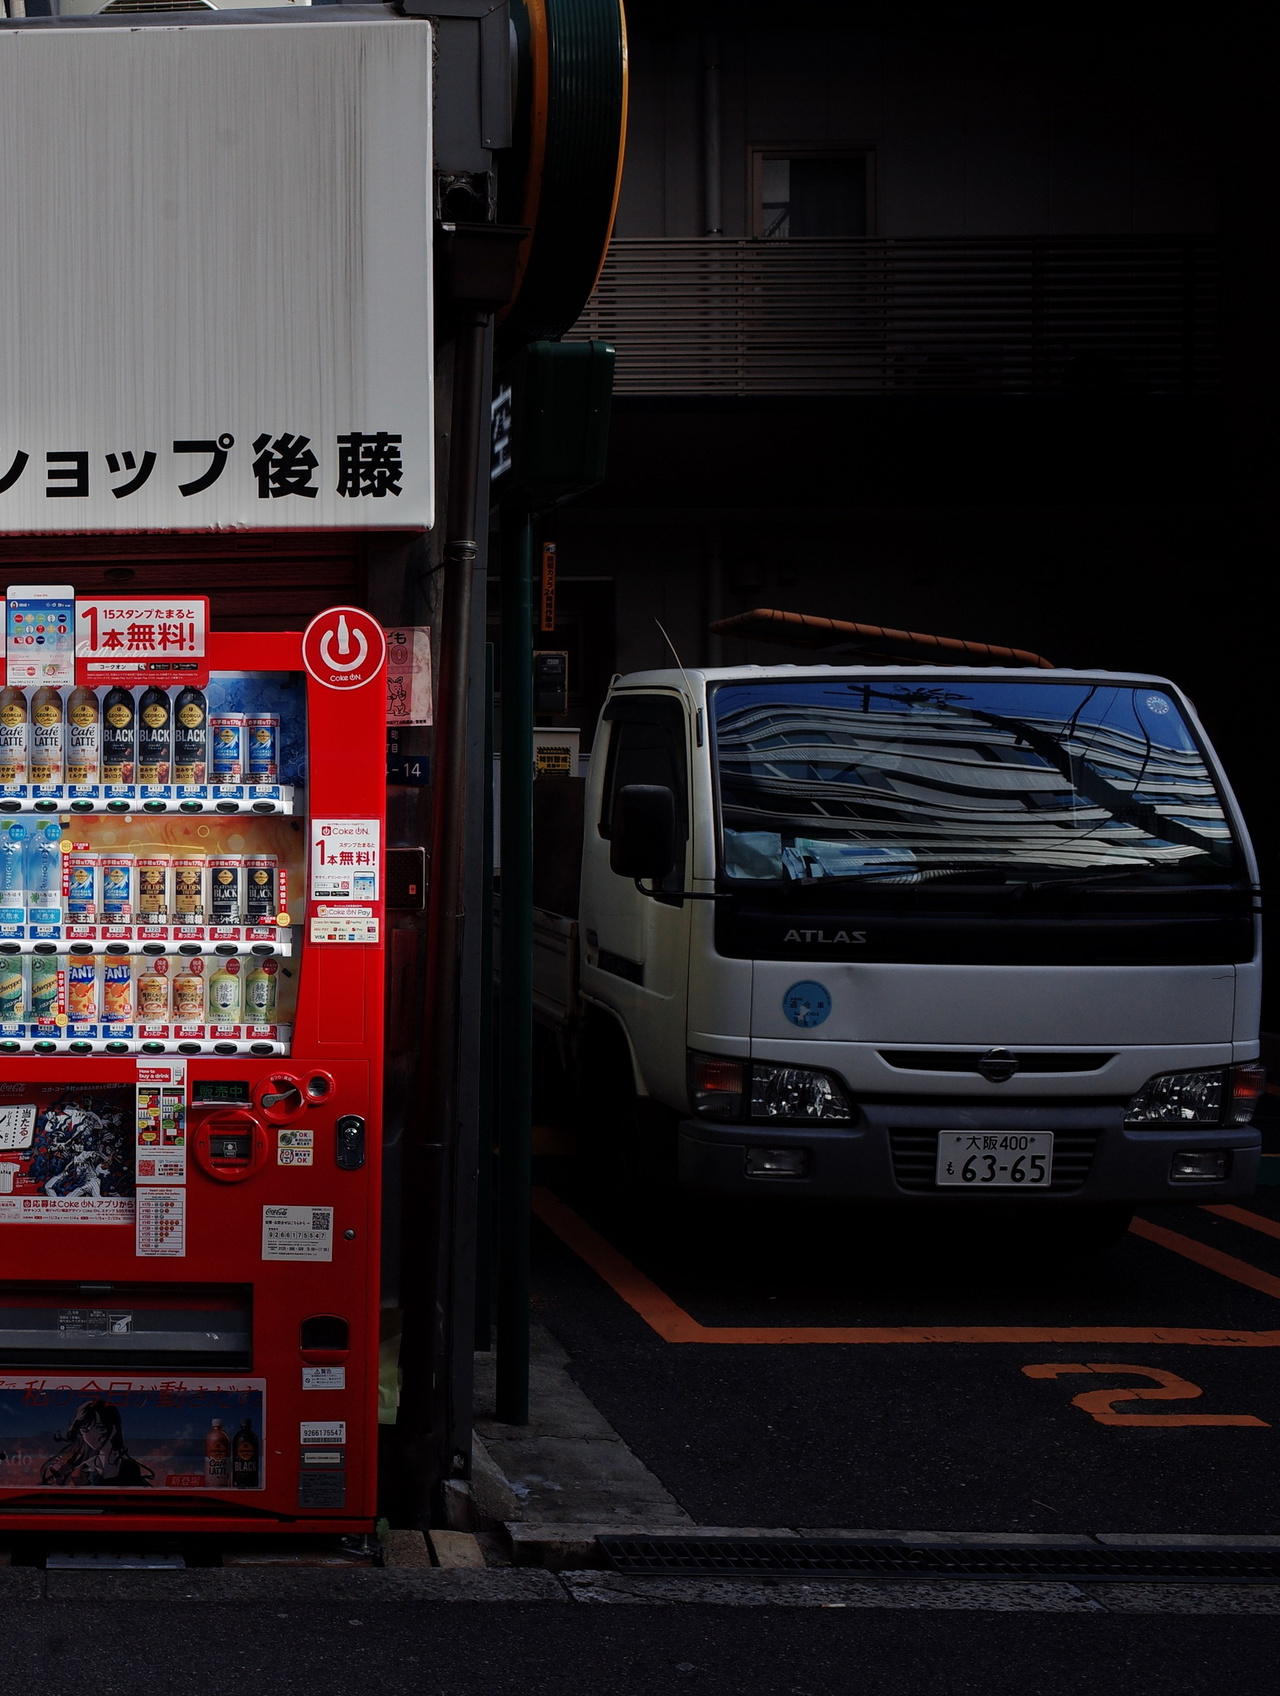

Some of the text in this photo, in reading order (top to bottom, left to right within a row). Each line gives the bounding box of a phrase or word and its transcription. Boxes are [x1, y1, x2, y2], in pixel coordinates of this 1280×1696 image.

[102, 609, 195, 620] 15スタンプたまると
[0, 726, 23, 736] Café
[35, 726, 59, 736] Café
[71, 726, 94, 736] Café
[104, 730, 134, 742] BLACK
[140, 730, 169, 742] BLACK
[176, 730, 205, 742] BLACK
[0, 737, 23, 747] LATTE
[35, 737, 59, 747] LATTE
[71, 737, 94, 747] LATTE
[386, 763, 421, 778] -14
[214, 890, 238, 898] BLACK
[250, 890, 273, 898] BLACK
[783, 929, 867, 944] ATLAS
[200, 1085, 243, 1097] 販売中
[946, 1154, 1046, 1183] も 63-65
[58, 1200, 79, 1208] Coke
[97, 1200, 134, 1208] アプリから
[22, 1380, 263, 1408] 私の今日が動きだす。
[1021, 1362, 1272, 1428] 2
[304, 1429, 342, 1437] 9266175547
[209, 1467, 227, 1475] LATTE
[235, 1462, 256, 1471] BLACK
